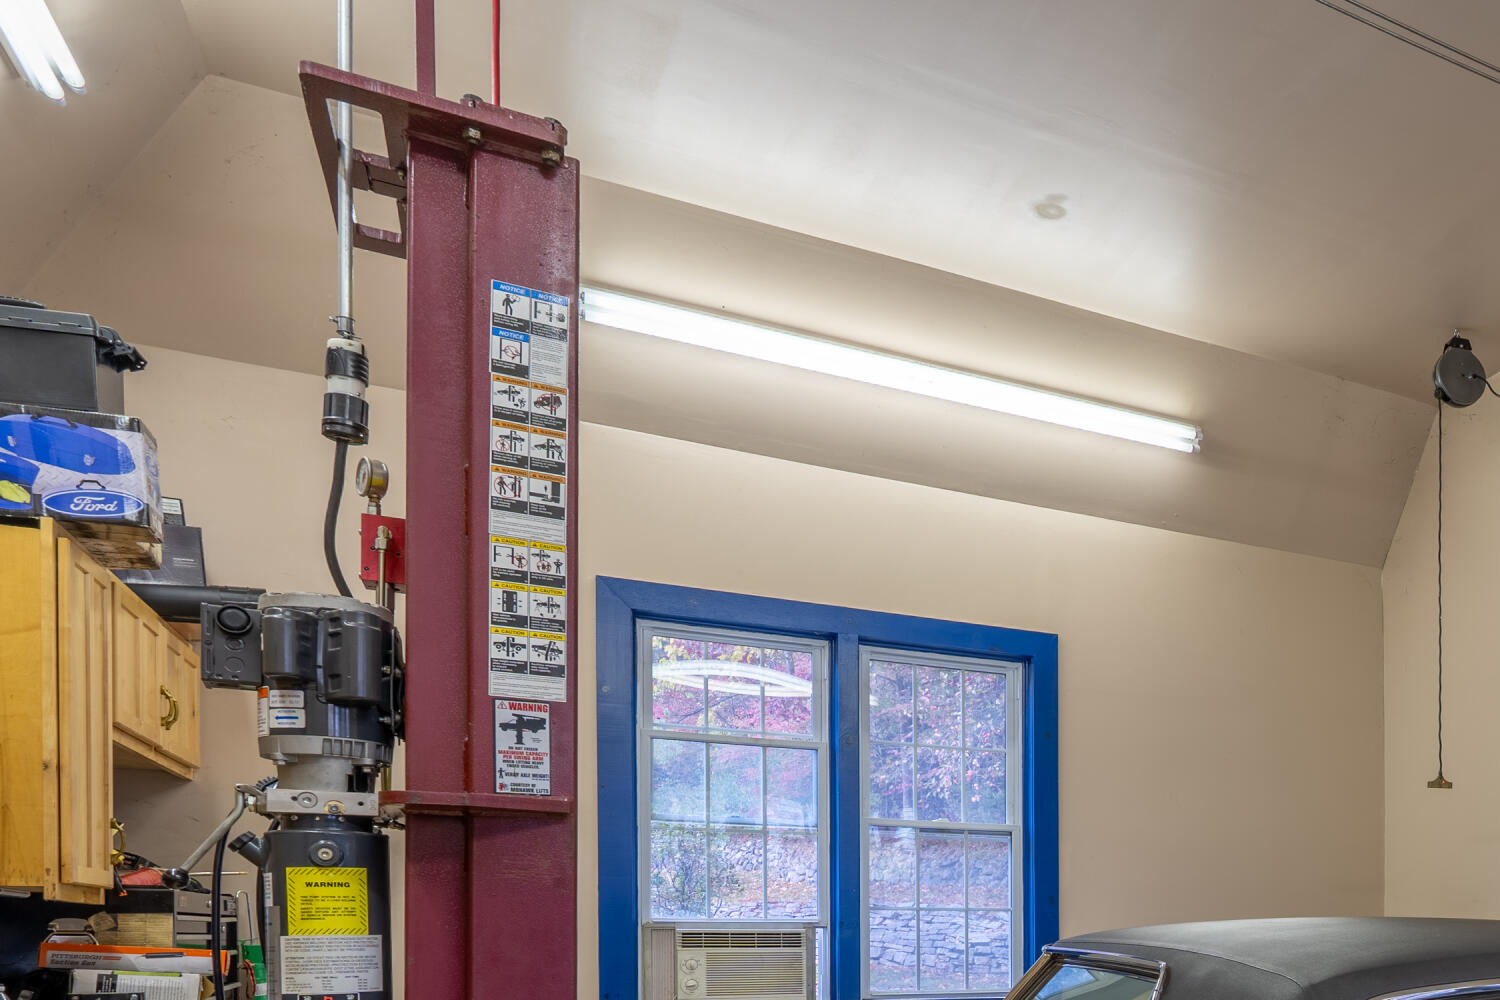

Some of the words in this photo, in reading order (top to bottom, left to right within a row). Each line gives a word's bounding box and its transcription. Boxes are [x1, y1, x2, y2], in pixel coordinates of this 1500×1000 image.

[499, 284, 526, 295] NOTICE
[538, 293, 563, 304] NOTICE
[498, 330, 525, 340] NOTICE
[69, 495, 118, 512] Ford
[508, 702, 548, 713] WARNING
[51, 953, 103, 961] PITTSBURGH
